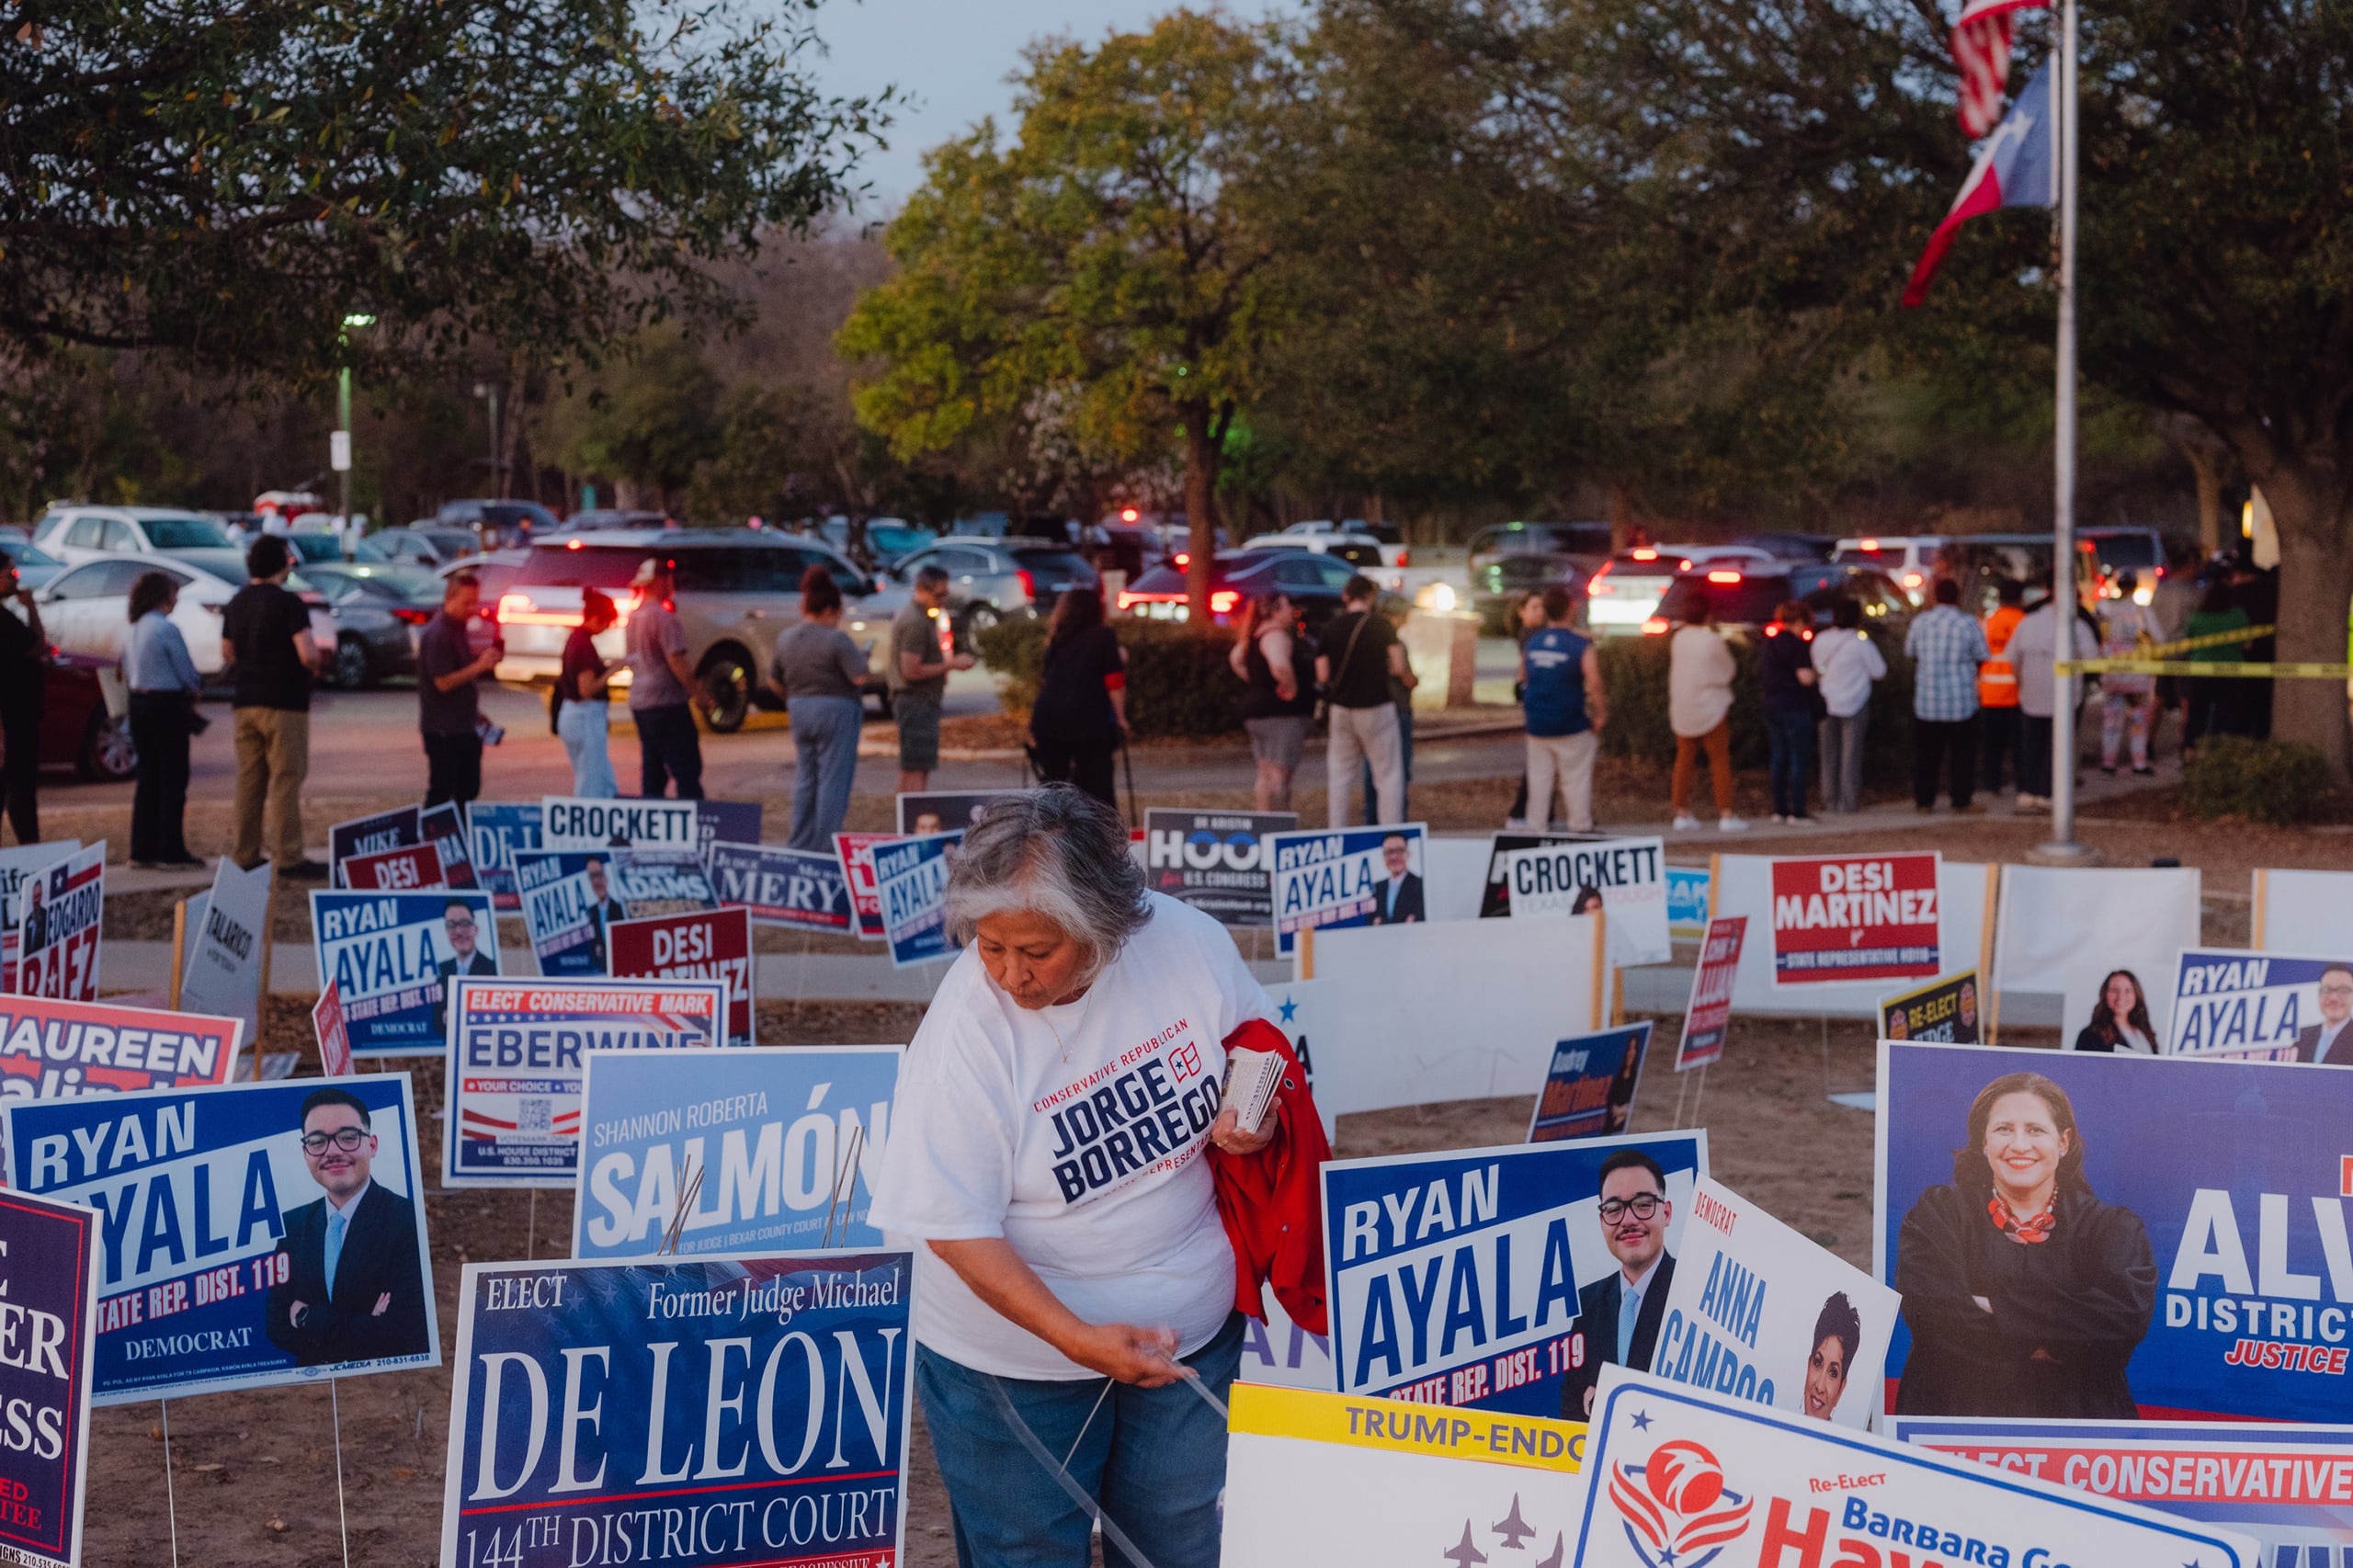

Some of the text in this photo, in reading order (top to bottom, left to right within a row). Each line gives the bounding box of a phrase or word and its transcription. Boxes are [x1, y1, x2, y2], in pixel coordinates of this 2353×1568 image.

[551, 804, 691, 842] CROCKETT
[374, 856, 420, 890] DESI
[519, 856, 562, 890] RYAN
[879, 846, 920, 880] RYAN
[1279, 835, 1345, 871] RYAN
[1517, 846, 1656, 895] CROCKETT
[1820, 862, 1893, 893] DESI
[46, 881, 101, 948] EDGARDO
[532, 878, 589, 938] AYALA
[721, 869, 845, 913] MERY
[890, 862, 943, 924] AYALA
[1284, 857, 1375, 915] AYALA
[1775, 889, 1938, 931] MARTINEZ
[324, 898, 398, 939] RYAN
[653, 923, 712, 965] DESI
[336, 927, 439, 997] AYALA
[2181, 959, 2269, 995] RYAN
[471, 991, 710, 1014] ELECT CONSERVATIVE MARK
[1908, 993, 1958, 1030] RE-ELECT
[2177, 992, 2300, 1051] AYALA
[476, 1081, 507, 1092] YOUR
[509, 1081, 551, 1092] CHOICE
[1033, 1018, 1188, 1113] CONSERVATIVE REPUBLICAN
[594, 1091, 768, 1148] SHANNON ROBERTA
[1051, 1057, 1176, 1159] JORGE
[30, 1100, 196, 1190] RYAN
[588, 1083, 889, 1248] SALMÓN
[1051, 1074, 1221, 1205] BORREGO
[70, 1148, 286, 1286] YALA
[697, 1239, 722, 1252] JUDGE
[729, 1230, 756, 1245] BEXAR
[757, 1223, 792, 1243] COUNTY
[793, 1219, 823, 1235] COURT
[1342, 1164, 1500, 1263] RYAN
[1693, 1191, 1737, 1237] DEMOCRAT
[148, 1275, 189, 1321] REP.
[195, 1264, 245, 1306] DIST.
[252, 1252, 290, 1290] 119
[484, 1267, 900, 1324] ELECT Former Judge Michael
[1353, 1217, 1581, 1388] AYALA
[1698, 1248, 1768, 1350] ANNA
[125, 1326, 253, 1362] DEMOCRAT
[2166, 1293, 2353, 1342] DISTRIC
[1451, 1363, 1490, 1407] REP.
[1494, 1346, 1542, 1393] DIST.
[1547, 1332, 1585, 1376] 119
[2224, 1338, 2350, 1375] JUSTICE
[0, 1396, 63, 1469] SS
[468, 1327, 903, 1502] DE LEON
[2064, 1454, 2352, 1500] CONSERVATIVE
[467, 1486, 896, 1568] 144TH DISTRICT COURT
